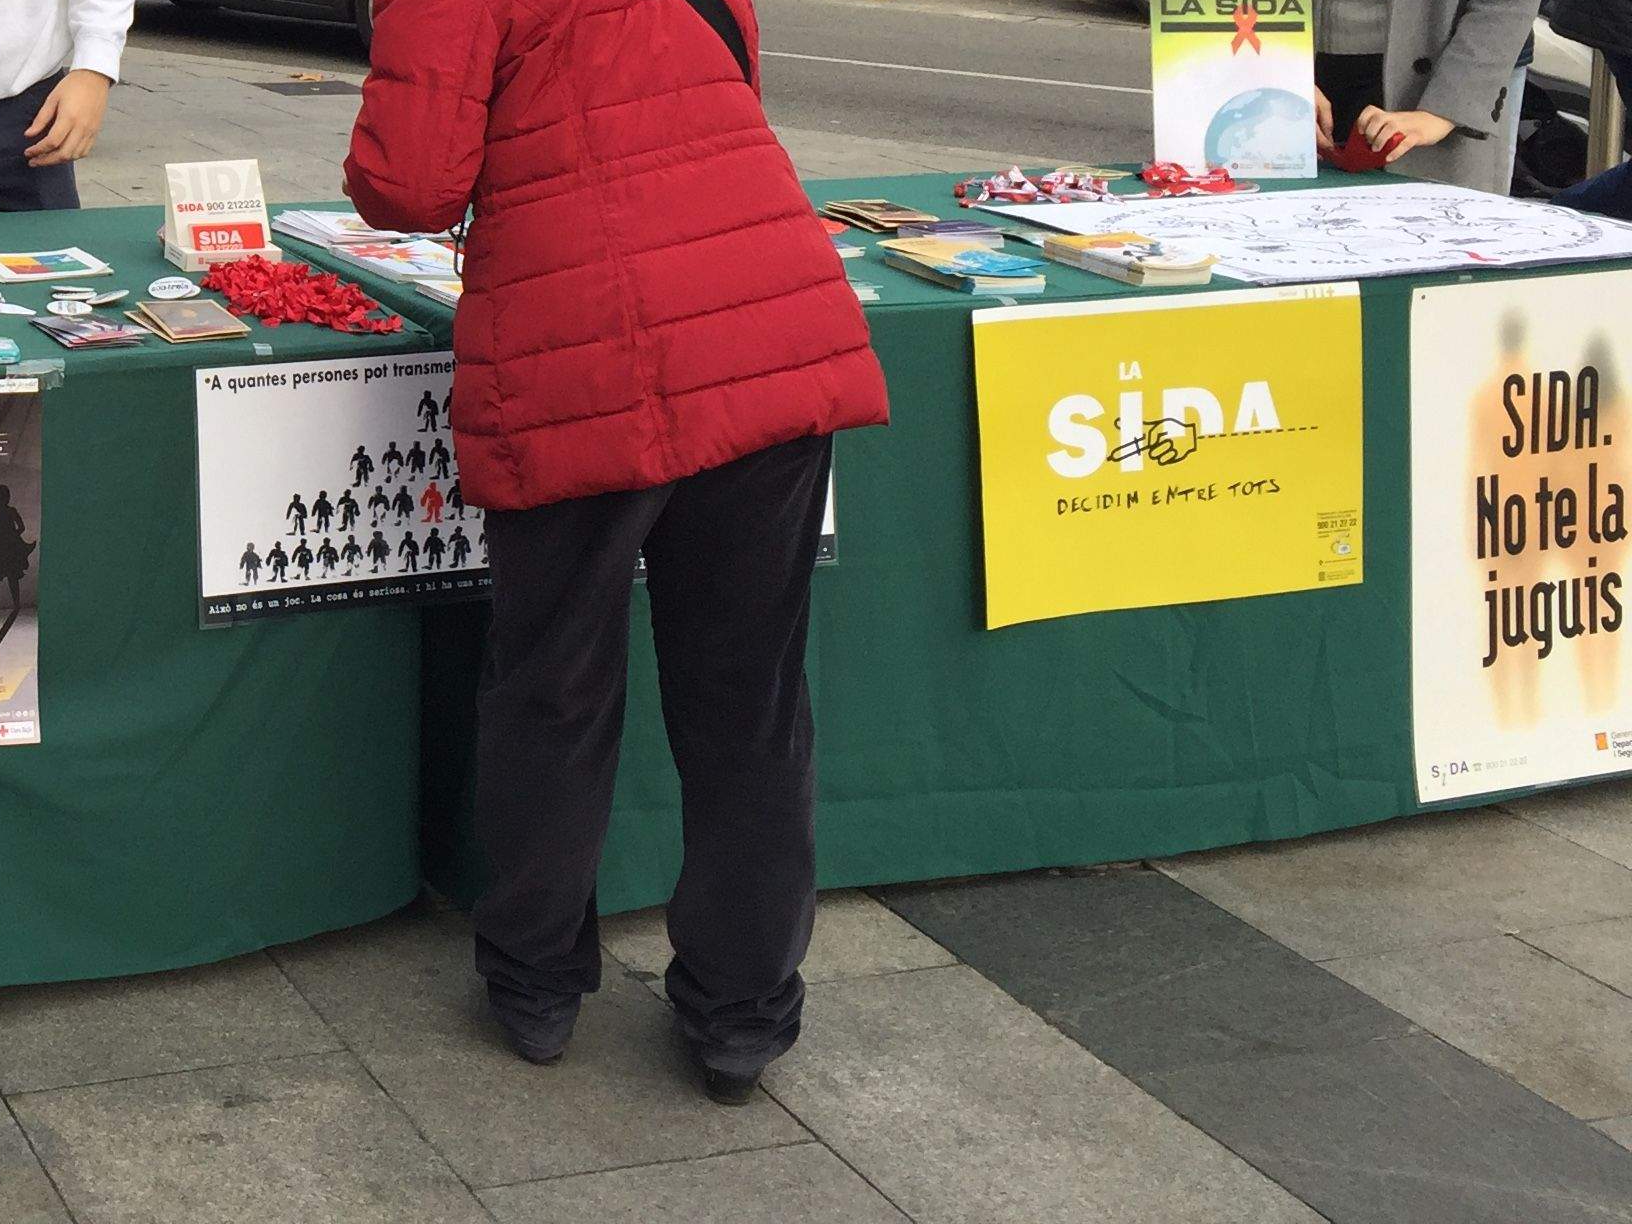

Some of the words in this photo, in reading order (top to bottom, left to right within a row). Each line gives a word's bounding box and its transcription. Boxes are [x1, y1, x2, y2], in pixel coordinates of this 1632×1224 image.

[176, 203, 204, 213] SIDA
[206, 202, 225, 211] 900
[198, 229, 243, 245] SIDA
[228, 371, 287, 394] quantes
[292, 366, 359, 389] persones
[364, 363, 388, 383] pot
[1118, 360, 1143, 381] LA
[1501, 365, 1612, 458] SIDA.
[1057, 493, 1139, 516] DECIDIM
[1151, 482, 1217, 506] ENTRE
[1228, 478, 1281, 496] TOTS
[1476, 473, 1527, 560] No
[1535, 476, 1578, 550] te
[1587, 462, 1629, 545] la
[208, 603, 232, 616] Això
[236, 602, 248, 612] no
[252, 599, 264, 610] és
[267, 599, 280, 608] un
[284, 597, 305, 610] joc.
[310, 593, 322, 604] La
[326, 592, 349, 602] cosa
[352, 589, 364, 600] és
[415, 584, 421, 593] I
[425, 581, 437, 591] hi
[440, 580, 453, 590] ha
[456, 579, 474, 588] una
[1482, 556, 1623, 668] juguis
